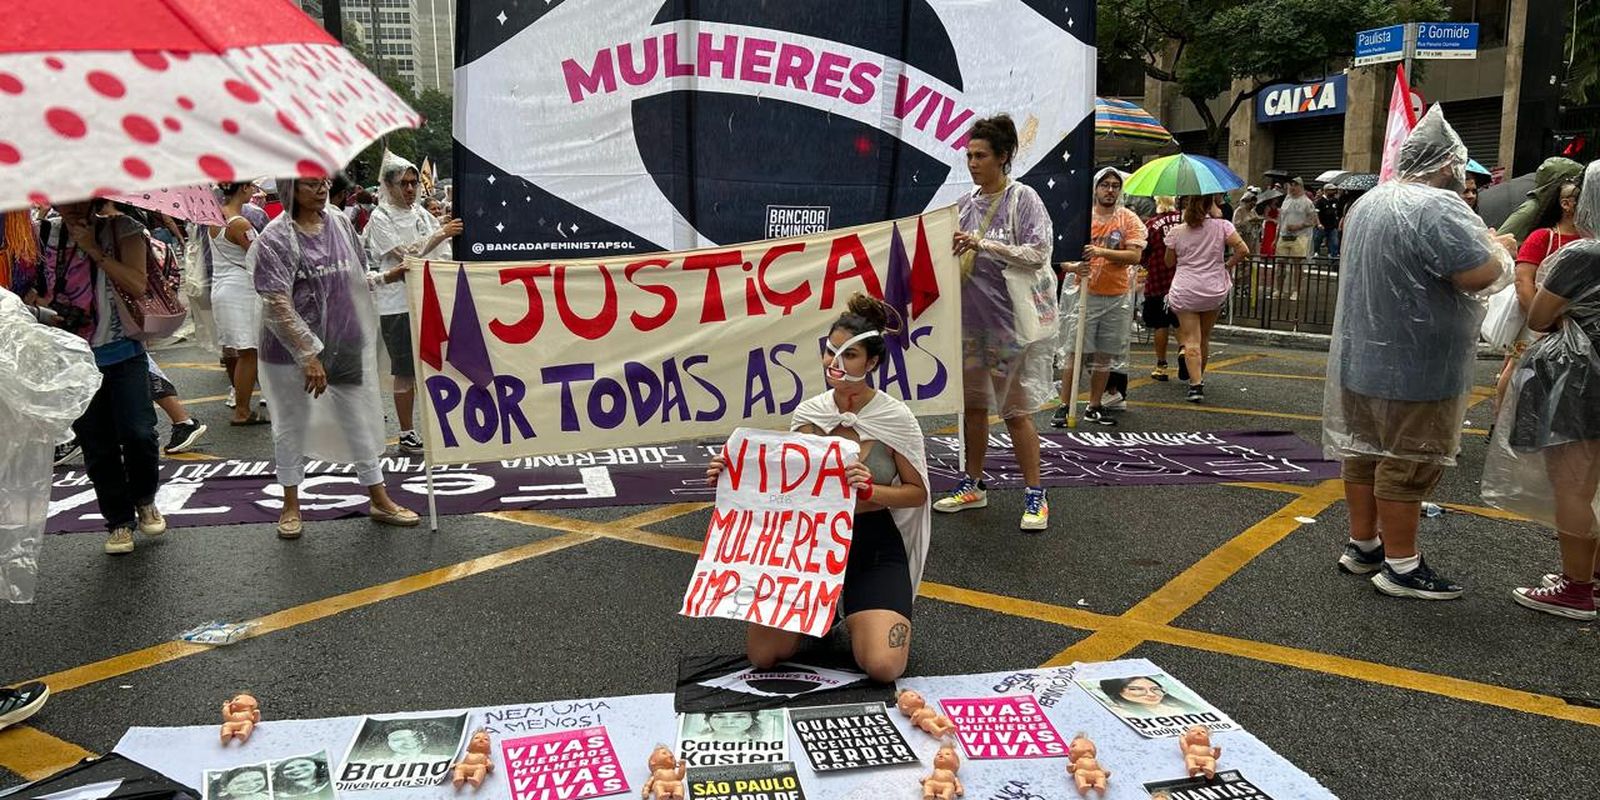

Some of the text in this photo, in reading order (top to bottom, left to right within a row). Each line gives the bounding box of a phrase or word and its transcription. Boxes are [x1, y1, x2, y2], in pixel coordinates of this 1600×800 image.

[1359, 31, 1391, 46] Paulista
[1418, 25, 1470, 39] P. Gomide
[561, 32, 882, 104] MULHERES
[1264, 82, 1336, 116] CAIXA
[769, 209, 826, 225] BANCADA
[425, 375, 537, 448] POR
[743, 343, 803, 419] AS
[724, 438, 850, 498] VIDA
[700, 508, 852, 576] MULHERES
[485, 700, 611, 725] NEM UMA
[946, 702, 1036, 716] VIVAS
[796, 714, 888, 732] QUANTAS
[955, 715, 1042, 724] QUEREMOS
[959, 722, 1048, 731] MULHERES
[802, 725, 895, 742] MULHERES
[960, 731, 1055, 744] VIVAS
[507, 736, 605, 761] VIVAS
[681, 739, 784, 751] Catarina
[807, 735, 901, 751] ACEITAMOS
[967, 743, 1065, 756] VIVAS
[511, 748, 609, 769] QUEREMOS
[681, 751, 784, 767] Kasten
[811, 744, 910, 764] PERDER
[513, 755, 613, 777] MULHERES
[393, 779, 411, 787] da
[513, 764, 617, 792] VIVAS
[693, 776, 796, 796] SÃO PAULO
[516, 778, 622, 800] VIVAS
[1171, 781, 1257, 800] UANTAS
